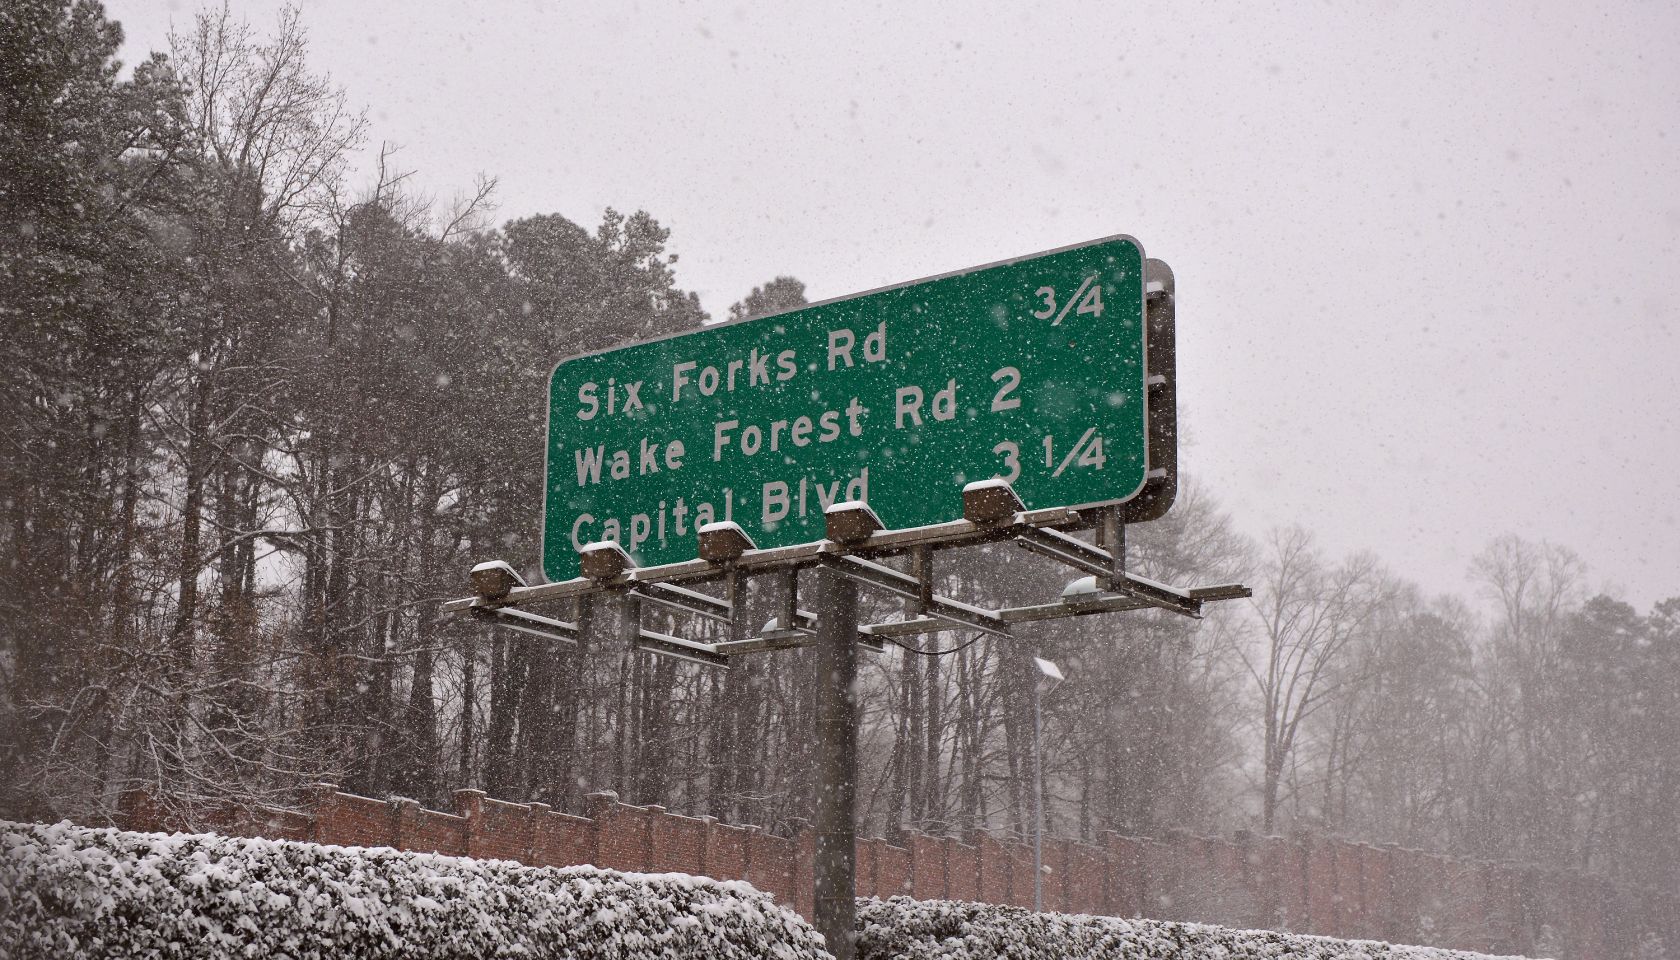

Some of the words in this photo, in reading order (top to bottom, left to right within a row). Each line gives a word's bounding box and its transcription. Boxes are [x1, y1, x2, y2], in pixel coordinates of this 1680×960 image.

[576, 378, 644, 420] Six
[672, 347, 797, 402] Forks
[828, 321, 886, 371] Rd
[1034, 275, 1105, 326] 3/4
[575, 438, 685, 486] Wake
[713, 397, 863, 462] Forest
[895, 378, 956, 429] Rd
[990, 366, 1021, 413] 2
[571, 488, 733, 553] Capital
[762, 466, 868, 523] Blvd
[991, 441, 1021, 485] 3
[1042, 427, 1106, 478] 1/4
